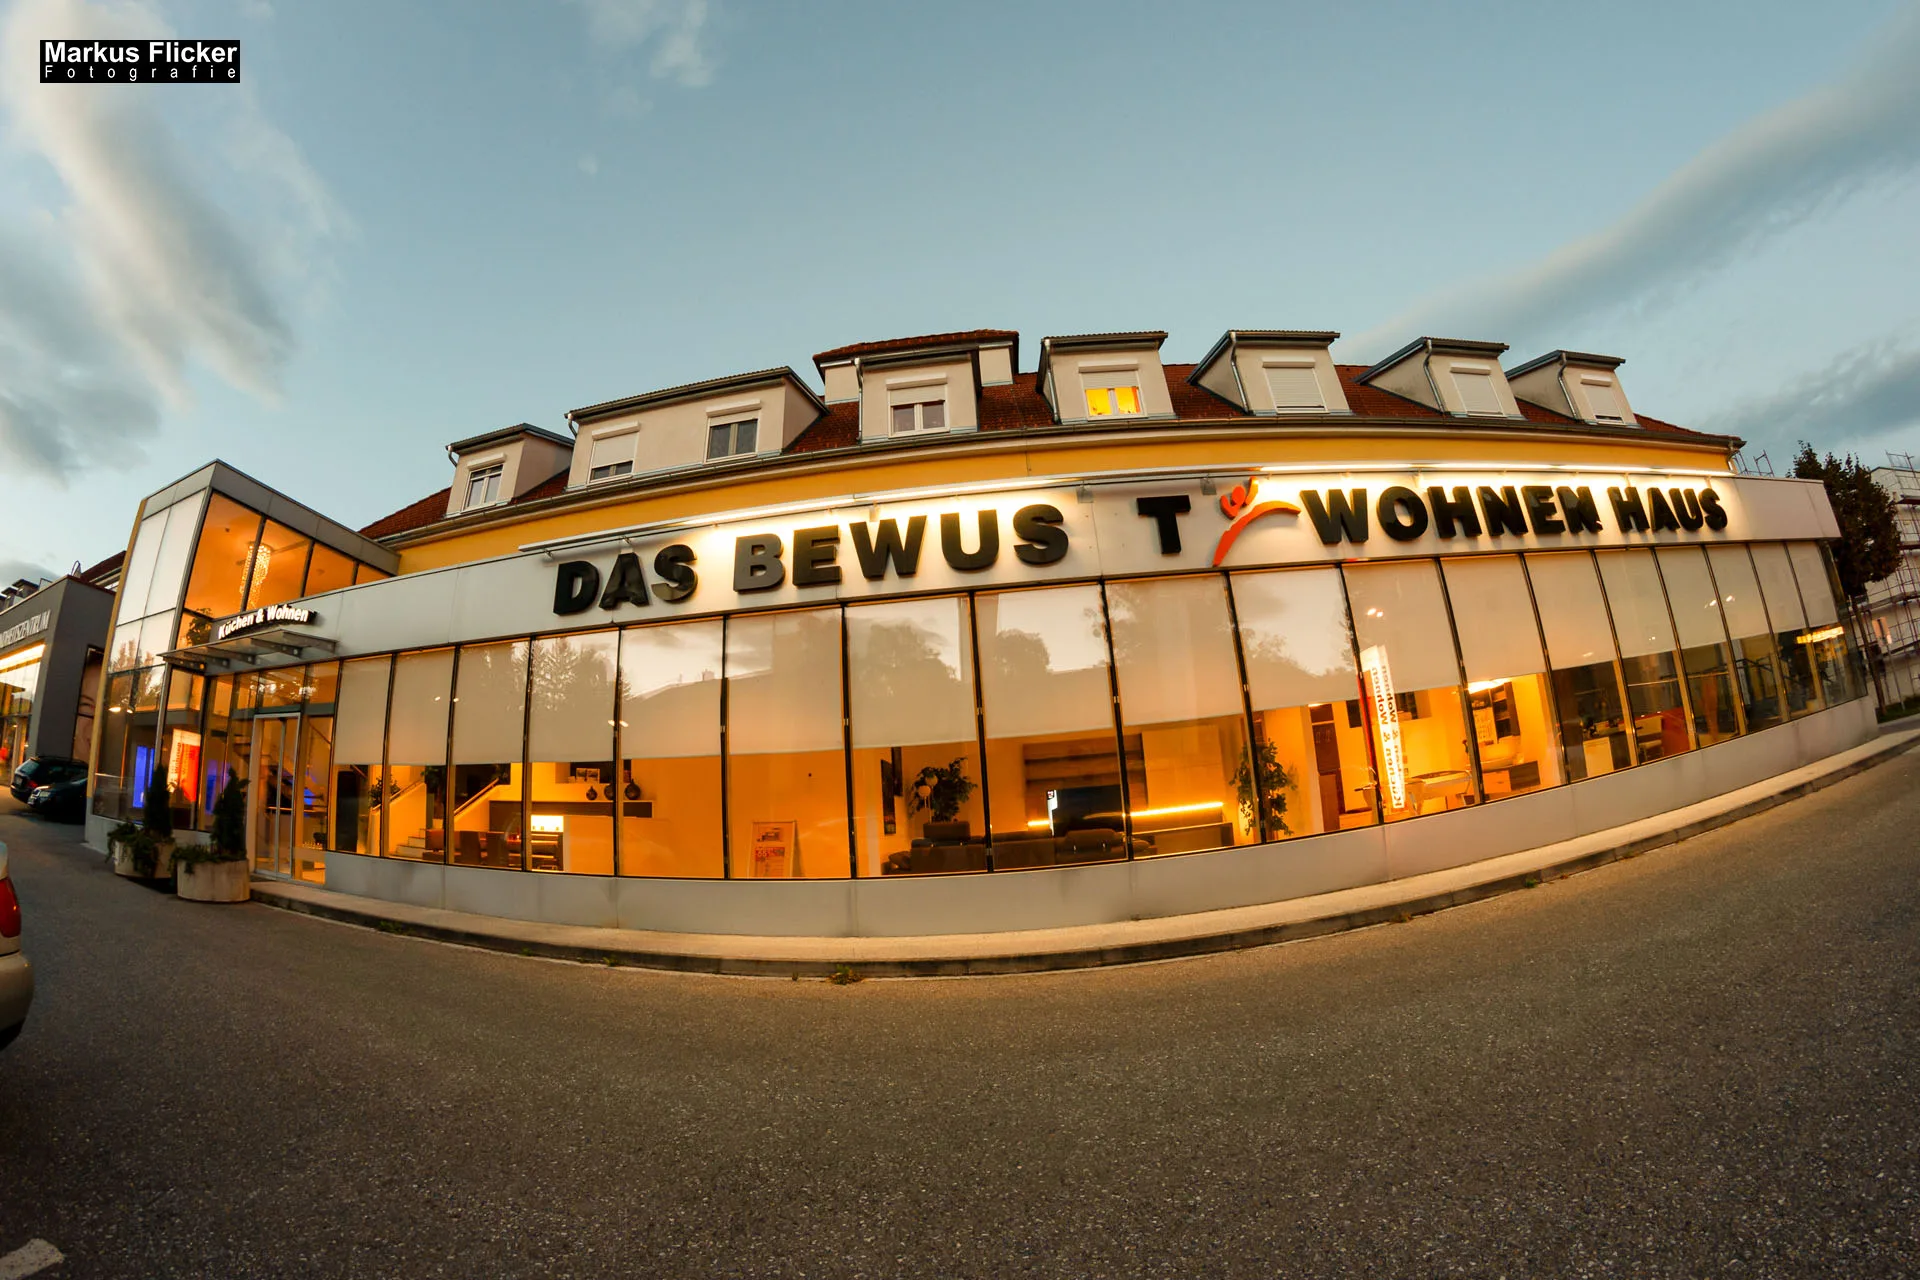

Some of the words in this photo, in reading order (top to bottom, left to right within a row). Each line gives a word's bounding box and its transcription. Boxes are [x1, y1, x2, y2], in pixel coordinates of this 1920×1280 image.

[552, 543, 698, 616] DAS
[1299, 484, 1602, 545] WOHNEN
[1607, 485, 1729, 533] HAUS
[218, 613, 254, 639] Küchen
[255, 608, 265, 624] &
[266, 603, 309, 623] Wohnen
